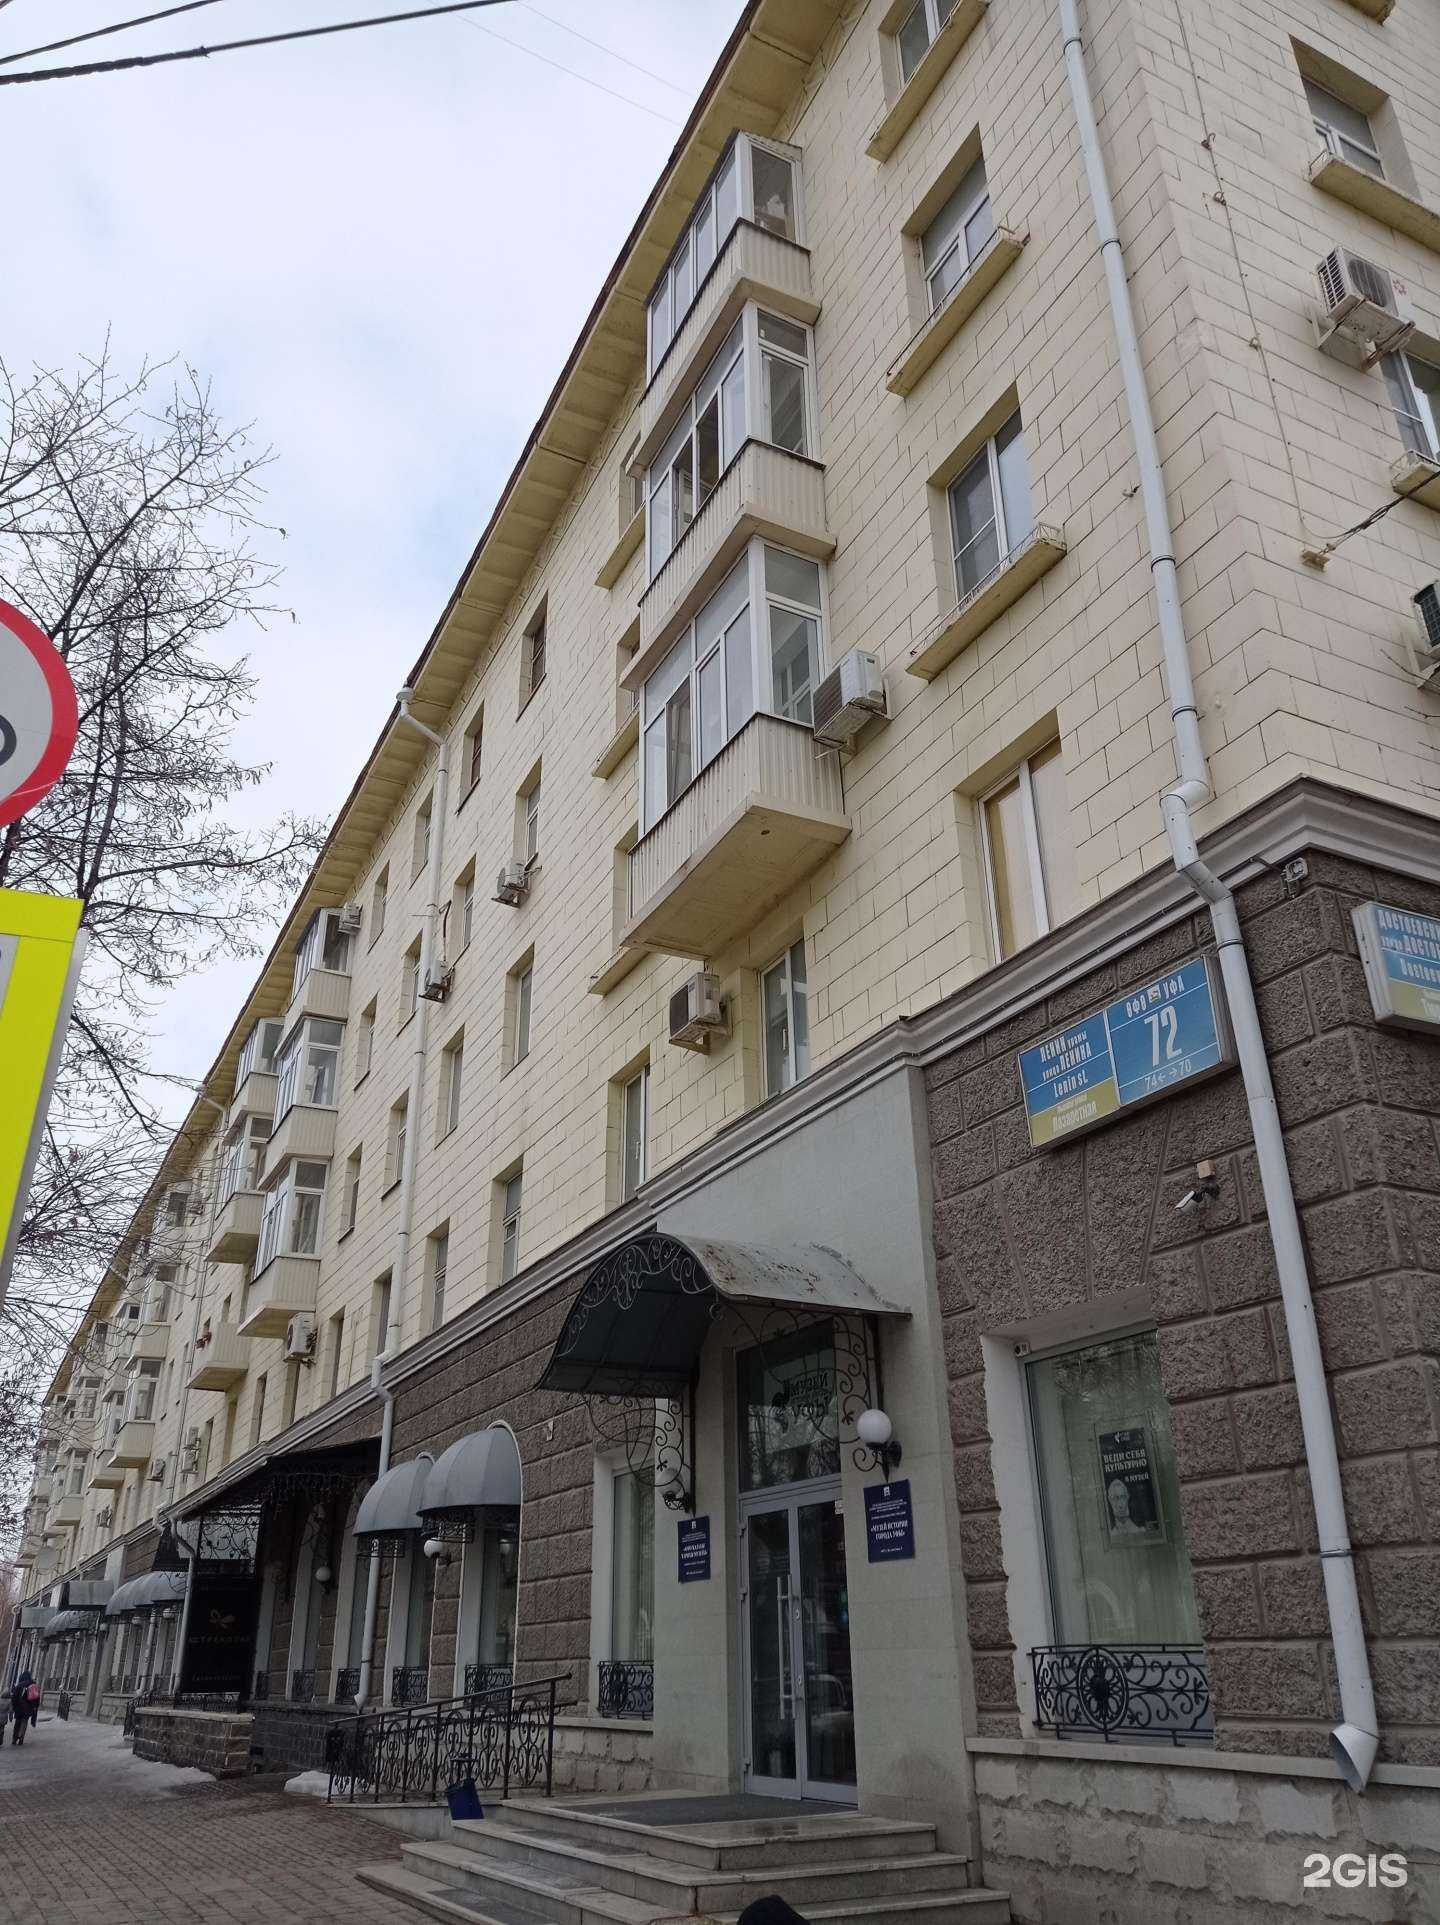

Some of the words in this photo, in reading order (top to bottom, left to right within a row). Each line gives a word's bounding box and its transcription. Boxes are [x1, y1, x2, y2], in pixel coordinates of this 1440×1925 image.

[1163, 975, 1185, 1000] УФА
[1144, 1005, 1182, 1067] 72
[1040, 1036, 1067, 1063] ЛЕНИН
[1060, 1041, 1092, 1071] ЛЕНИНА
[1179, 1059, 1192, 1076] 70
[1053, 1075, 1077, 1098] Lenin
[1144, 1074, 1158, 1090] 74
[1103, 1453, 1125, 1464] ВЕДИ
[1125, 1449, 1146, 1460] СЕБЯ
[1104, 1458, 1147, 1472] КУЛЬТУРНО
